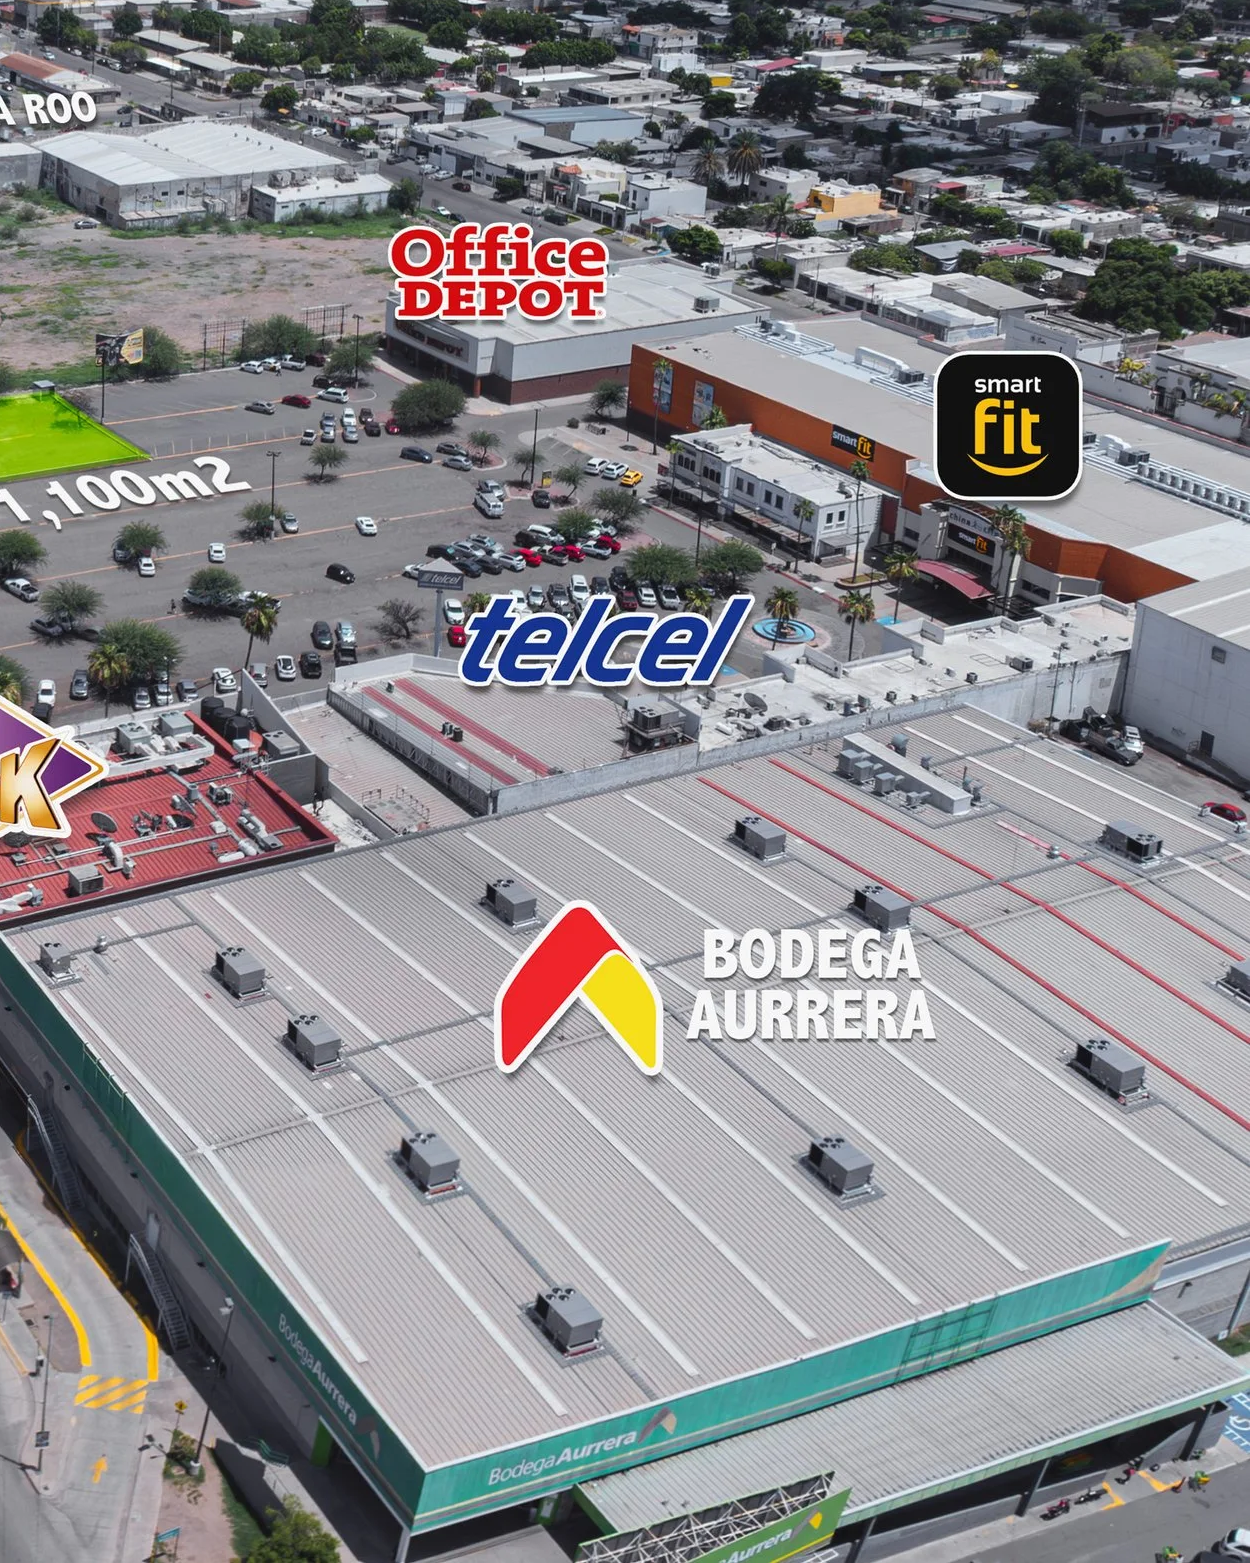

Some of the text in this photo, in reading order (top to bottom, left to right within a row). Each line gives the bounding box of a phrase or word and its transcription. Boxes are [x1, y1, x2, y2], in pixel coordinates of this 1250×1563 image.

[833, 431, 871, 455] smart fit
[431, 573, 461, 584] telcel
[278, 1313, 358, 1426] Bodega Aurrera
[488, 1429, 638, 1486] Bodega Aurrera
